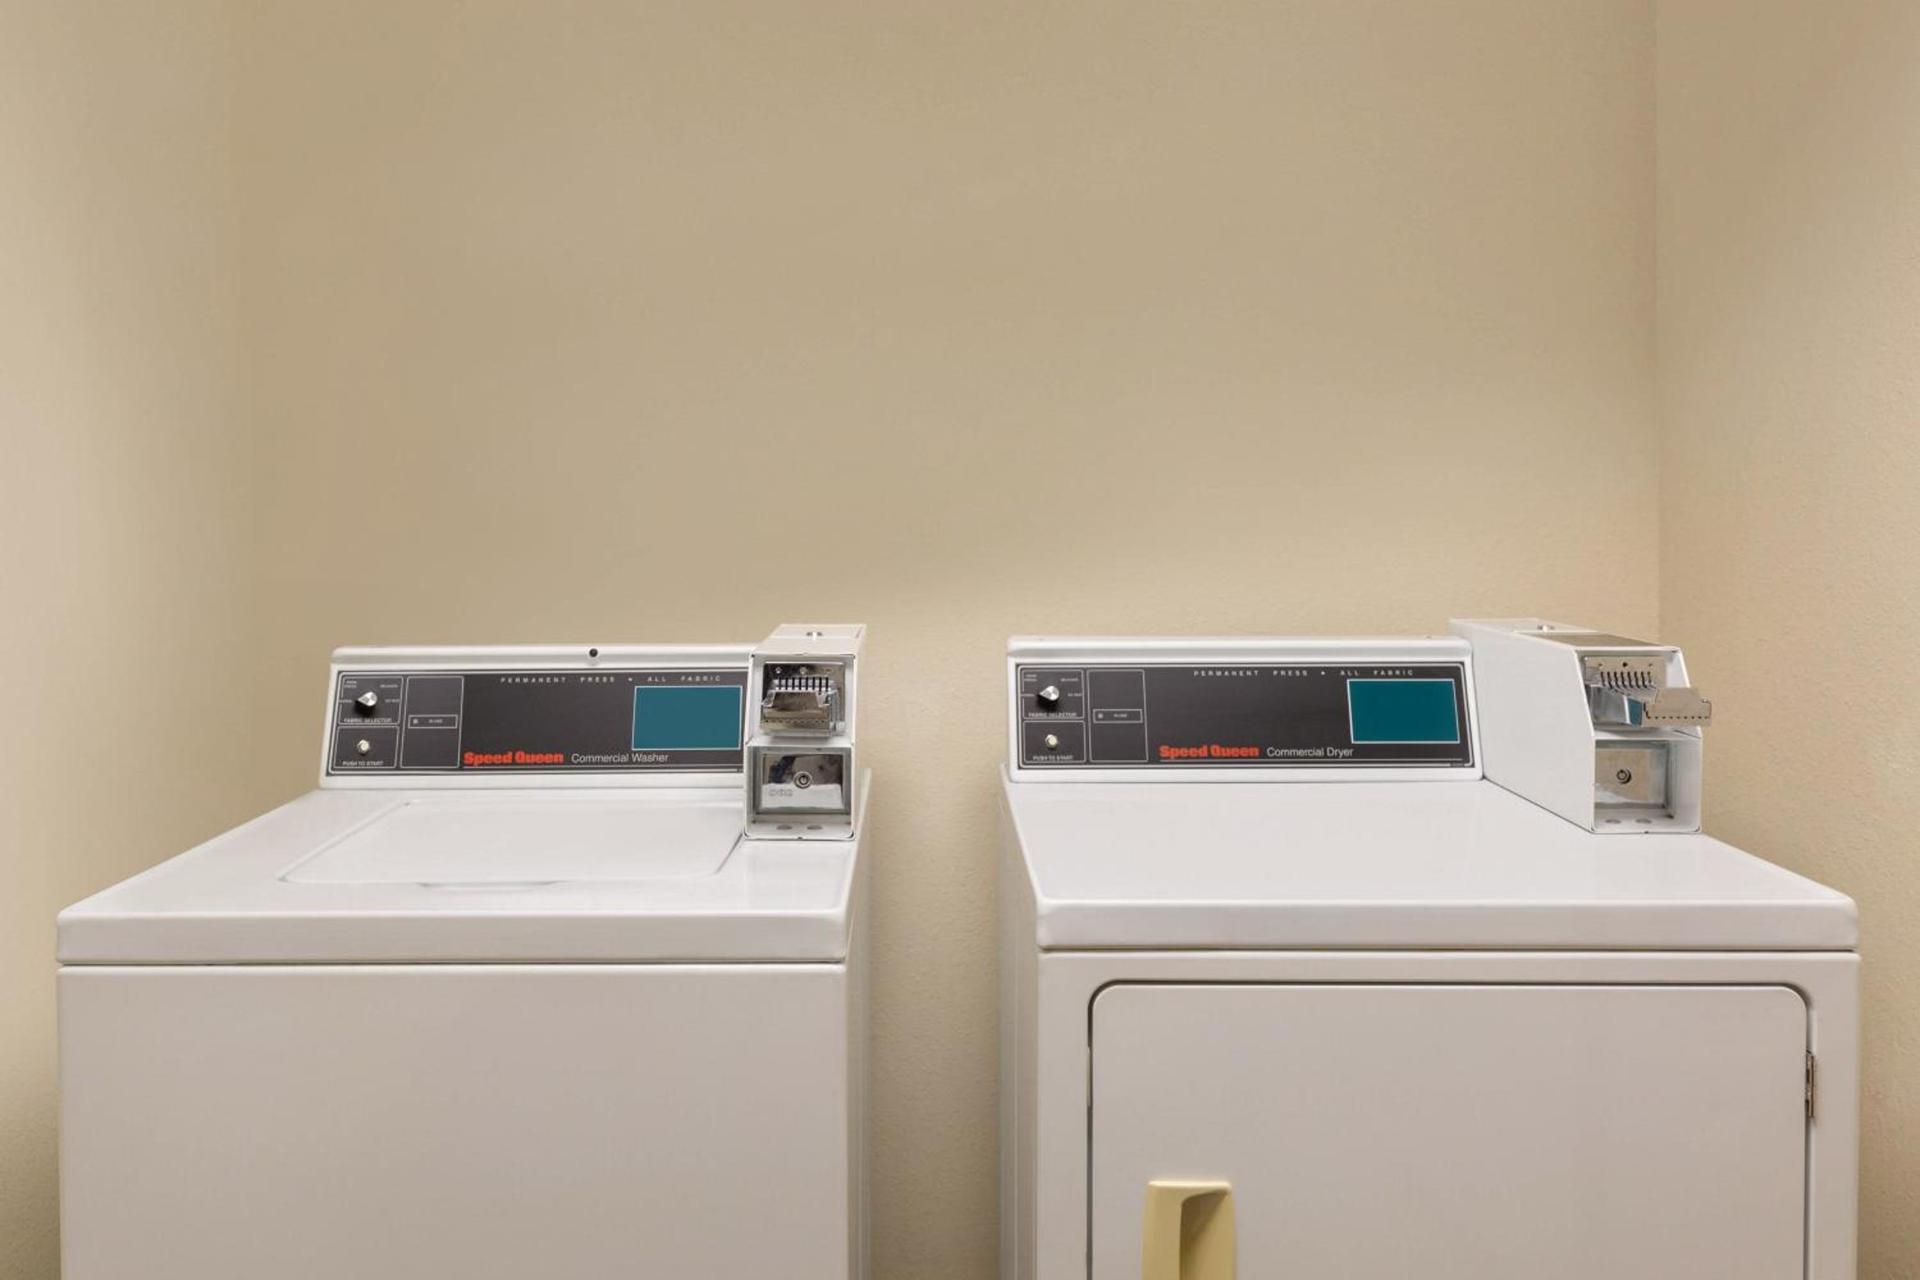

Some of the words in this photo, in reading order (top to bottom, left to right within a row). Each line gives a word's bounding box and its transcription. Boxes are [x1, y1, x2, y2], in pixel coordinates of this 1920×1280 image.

[463, 752, 513, 766] Speed
[514, 751, 564, 764] Queen
[571, 752, 629, 764] Commercial
[632, 752, 669, 763] Washer
[1159, 745, 1208, 759] Speed
[1210, 745, 1260, 758] Queen
[1266, 747, 1324, 758] Commercial
[1326, 747, 1354, 759] Dryer
